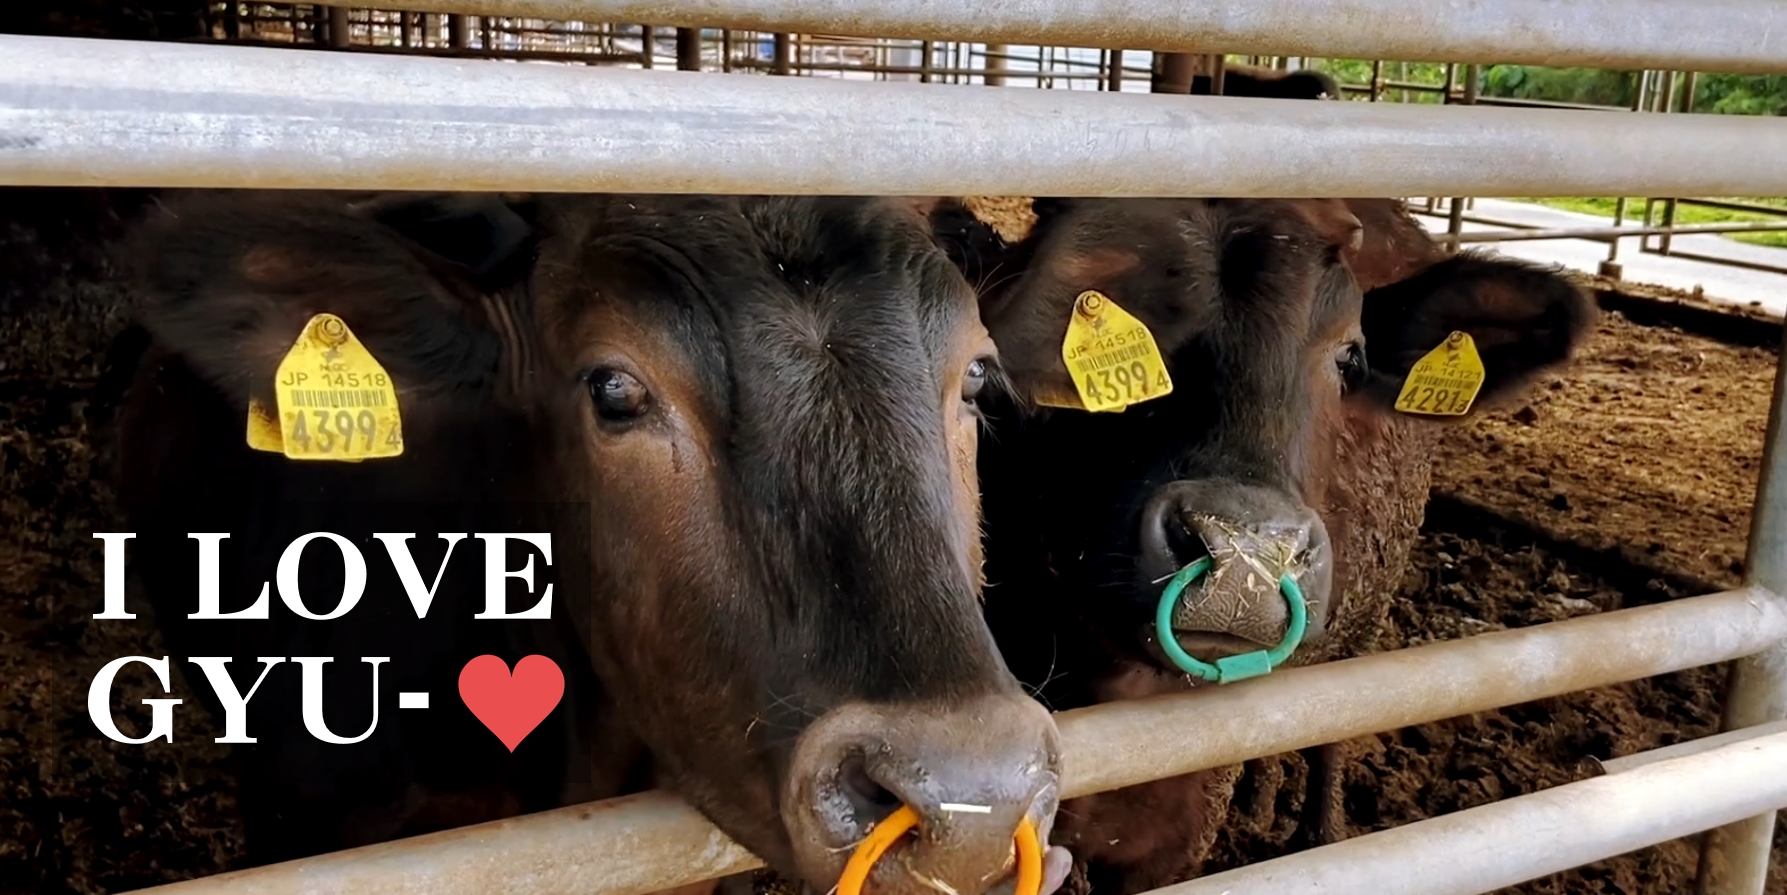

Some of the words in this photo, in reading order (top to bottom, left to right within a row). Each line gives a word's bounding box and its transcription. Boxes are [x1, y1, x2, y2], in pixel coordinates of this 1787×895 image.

[1068, 345, 1087, 359] JP
[1095, 327, 1146, 351] 14518
[283, 372, 308, 386] JP
[321, 373, 386, 388] 14518
[1086, 361, 1147, 405] 4399
[1415, 365, 1433, 373] JP
[1441, 368, 1482, 379] 14121
[292, 409, 377, 453] 4399
